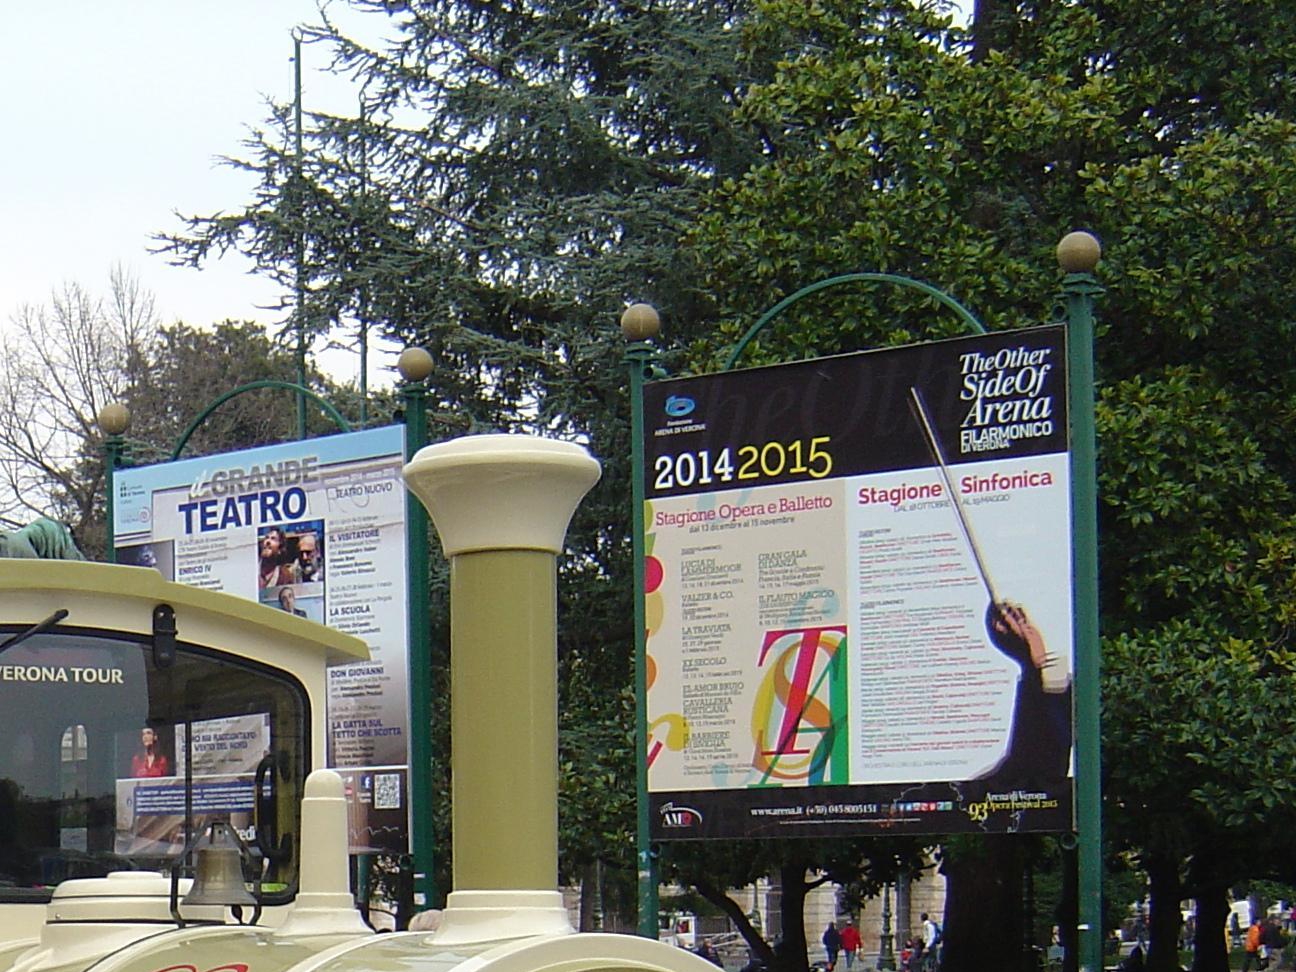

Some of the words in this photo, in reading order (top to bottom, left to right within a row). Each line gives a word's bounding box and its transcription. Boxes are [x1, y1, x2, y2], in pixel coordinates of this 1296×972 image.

[959, 347, 1051, 374] TheOther
[960, 364, 1051, 400] SideOf
[960, 397, 1052, 427] Arena
[960, 421, 1052, 444] FILARMONICO
[654, 447, 735, 490] 2014
[737, 436, 833, 479] 2015
[211, 456, 320, 497] GRANDE
[335, 485, 364, 499] TEATRO
[364, 482, 393, 496] NUOVO
[858, 483, 943, 506] Stagione
[960, 470, 1053, 494] Sinfonica
[178, 487, 308, 535] TEATRO
[655, 508, 716, 528] Stagione
[719, 502, 765, 523] Opera
[767, 502, 777, 514] e
[779, 496, 833, 513] Balletto
[710, 519, 742, 531] dicembre
[760, 515, 795, 527] novembre
[337, 528, 380, 542] VISITATORE
[329, 608, 339, 616] LA
[341, 605, 371, 615] SCUOLA
[694, 623, 732, 635] TRAVIATA
[70, 667, 124, 684] TOUR
[330, 669, 346, 678] DON
[348, 666, 384, 677] GIOVANNI
[332, 721, 342, 729] LA
[343, 720, 367, 729] GATTA
[368, 719, 383, 727] SUL
[332, 729, 356, 739] TETTO
[357, 728, 372, 738] CHE
[373, 727, 401, 737] SCOTTA
[968, 802, 988, 821] 93
